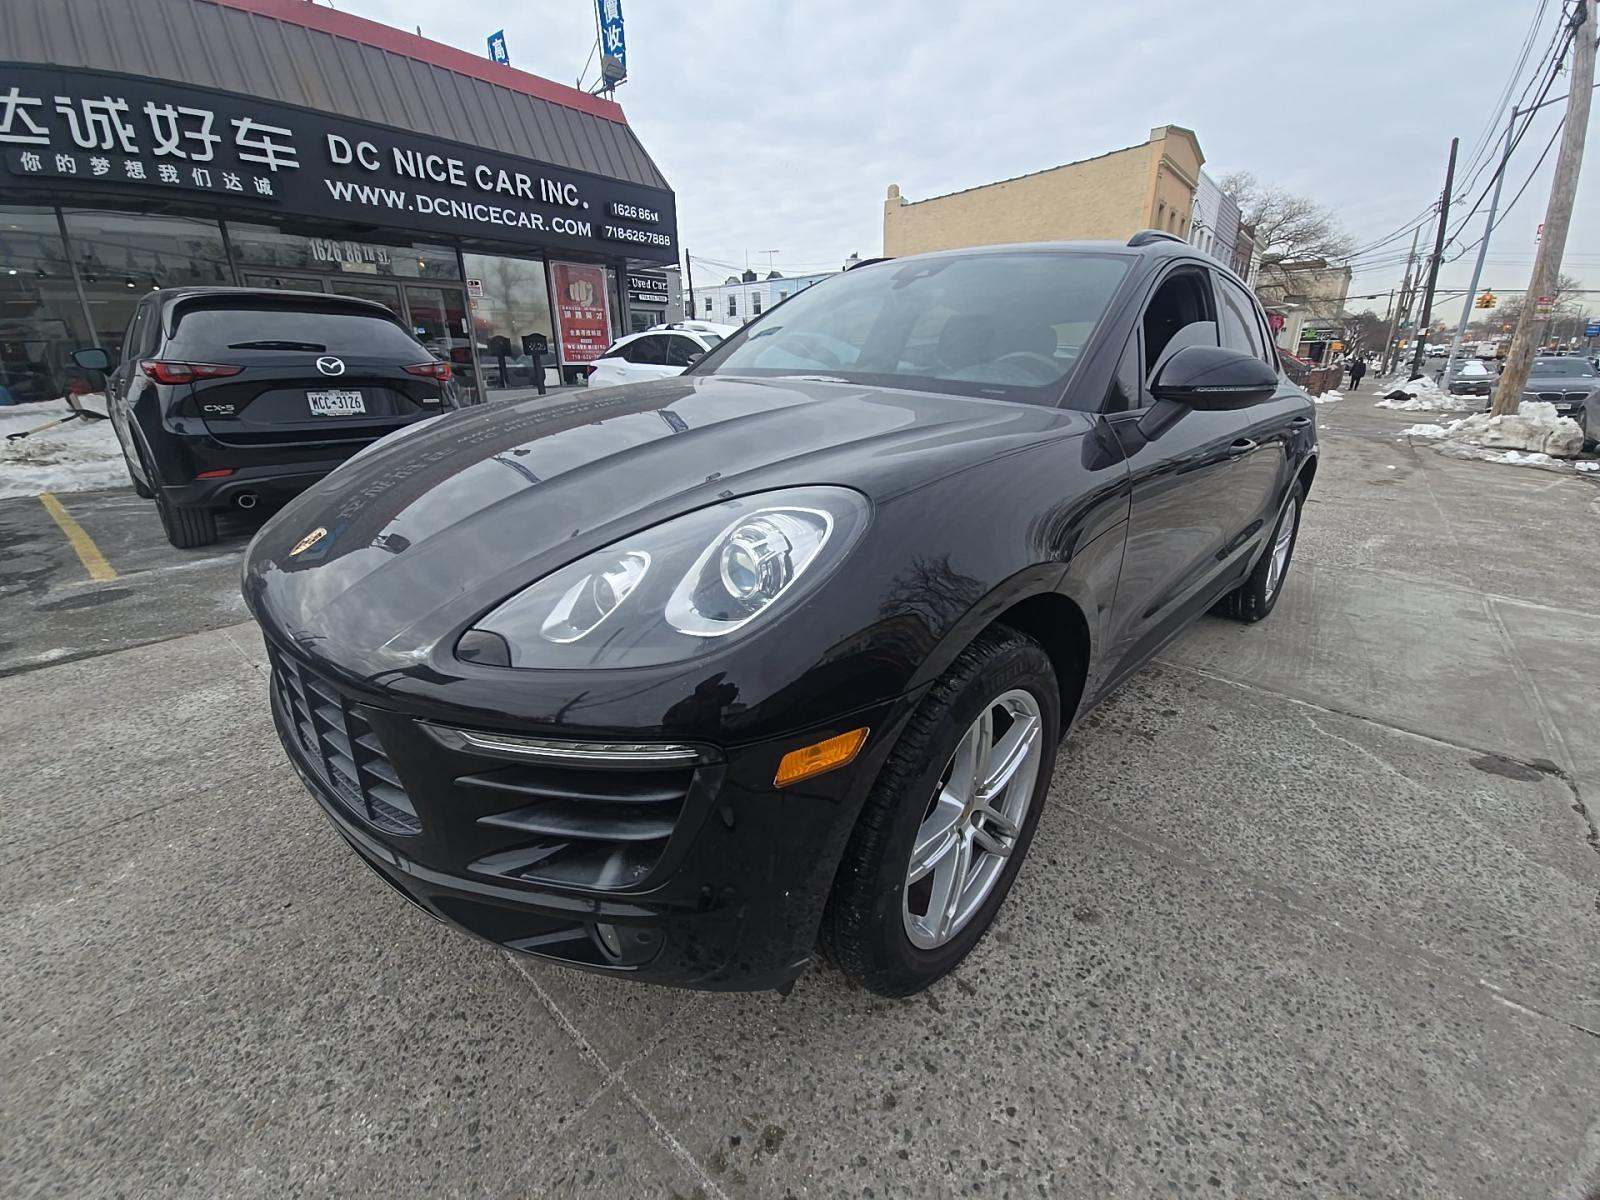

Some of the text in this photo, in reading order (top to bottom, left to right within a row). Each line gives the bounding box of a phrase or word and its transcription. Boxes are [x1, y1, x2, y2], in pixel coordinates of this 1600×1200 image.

[20, 151, 273, 196] 你的梦想我们达诚
[327, 133, 589, 209] DC NICE CAR INC.
[324, 179, 592, 238] WWW.DCNICECAR.COM
[613, 202, 637, 218] 1626
[605, 225, 671, 246] 718-626-7888
[309, 239, 342, 262] 1626
[632, 277, 667, 290] Used Car
[204, 404, 235, 412] CX-5
[311, 396, 361, 410] MCC 3126
